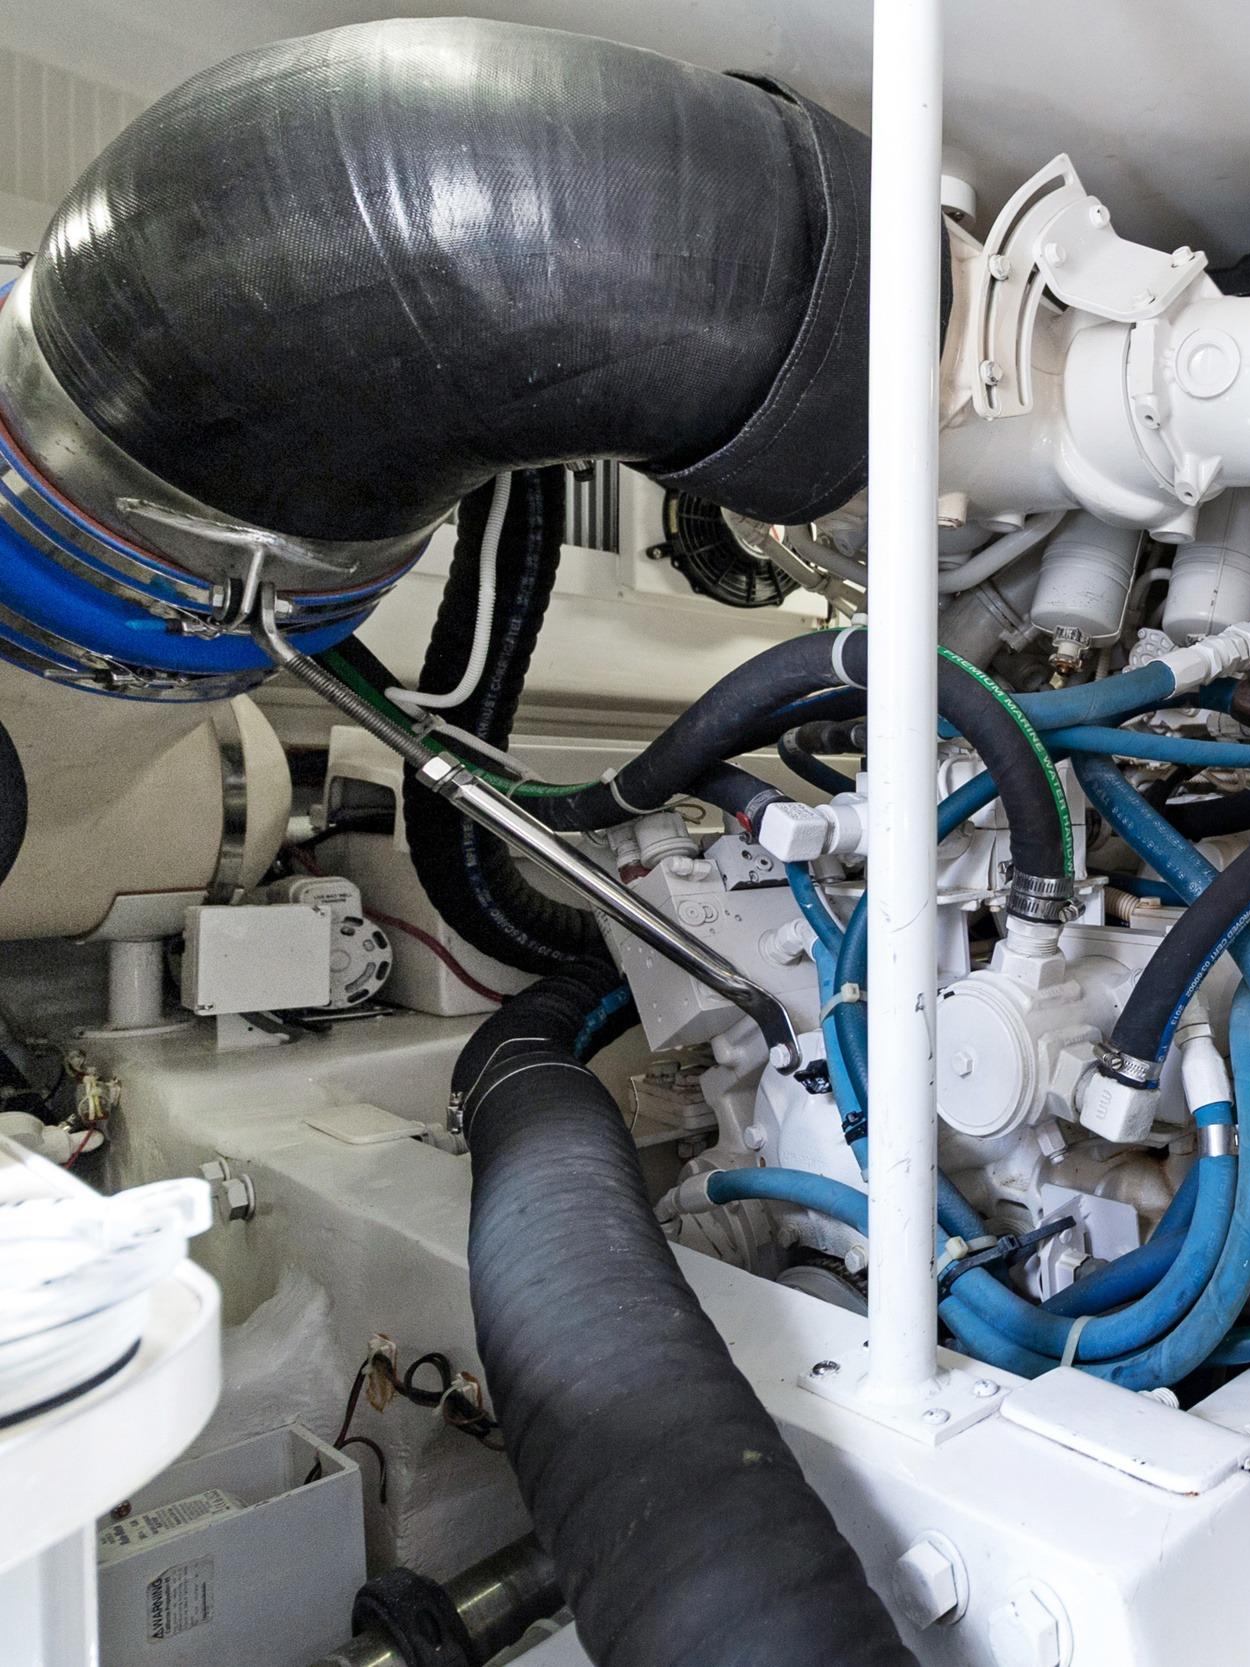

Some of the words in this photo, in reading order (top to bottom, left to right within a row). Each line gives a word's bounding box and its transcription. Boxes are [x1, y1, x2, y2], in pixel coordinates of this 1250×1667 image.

[944, 649, 1004, 696] PREMIUM
[1004, 698, 1045, 752] MARINE
[1043, 755, 1067, 810] WATER
[1063, 815, 1076, 877] HARDW
[1210, 938, 1228, 962] CERT
[1170, 1004, 1184, 1026] 2013
[151, 1577, 165, 1629] WARNING
